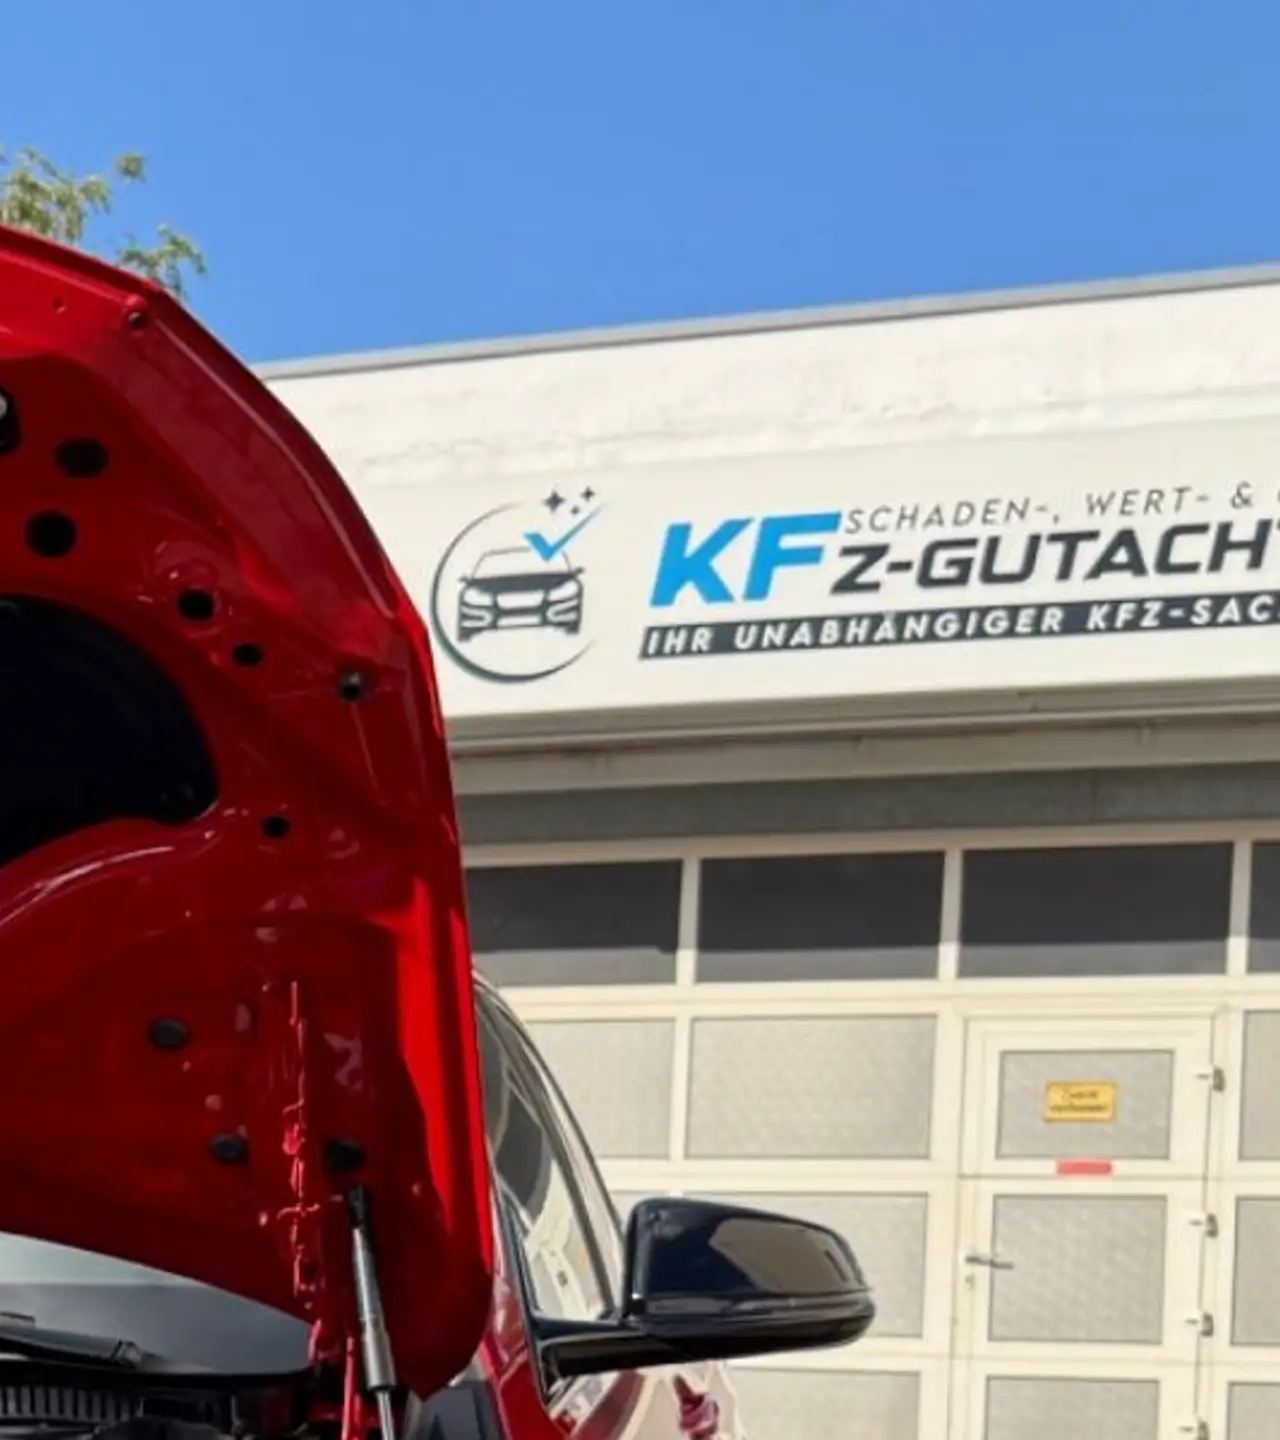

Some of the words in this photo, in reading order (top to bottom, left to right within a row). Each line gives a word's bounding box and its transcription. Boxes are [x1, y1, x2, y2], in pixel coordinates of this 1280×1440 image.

[1086, 486, 1209, 517] WERT-
[1230, 480, 1253, 510] &
[830, 518, 1280, 596] Z-GUTACH
[646, 628, 714, 655] IHR
[734, 606, 1065, 650] UNABHÄNGIGER
[1086, 594, 1280, 631] KFZ-SAC
